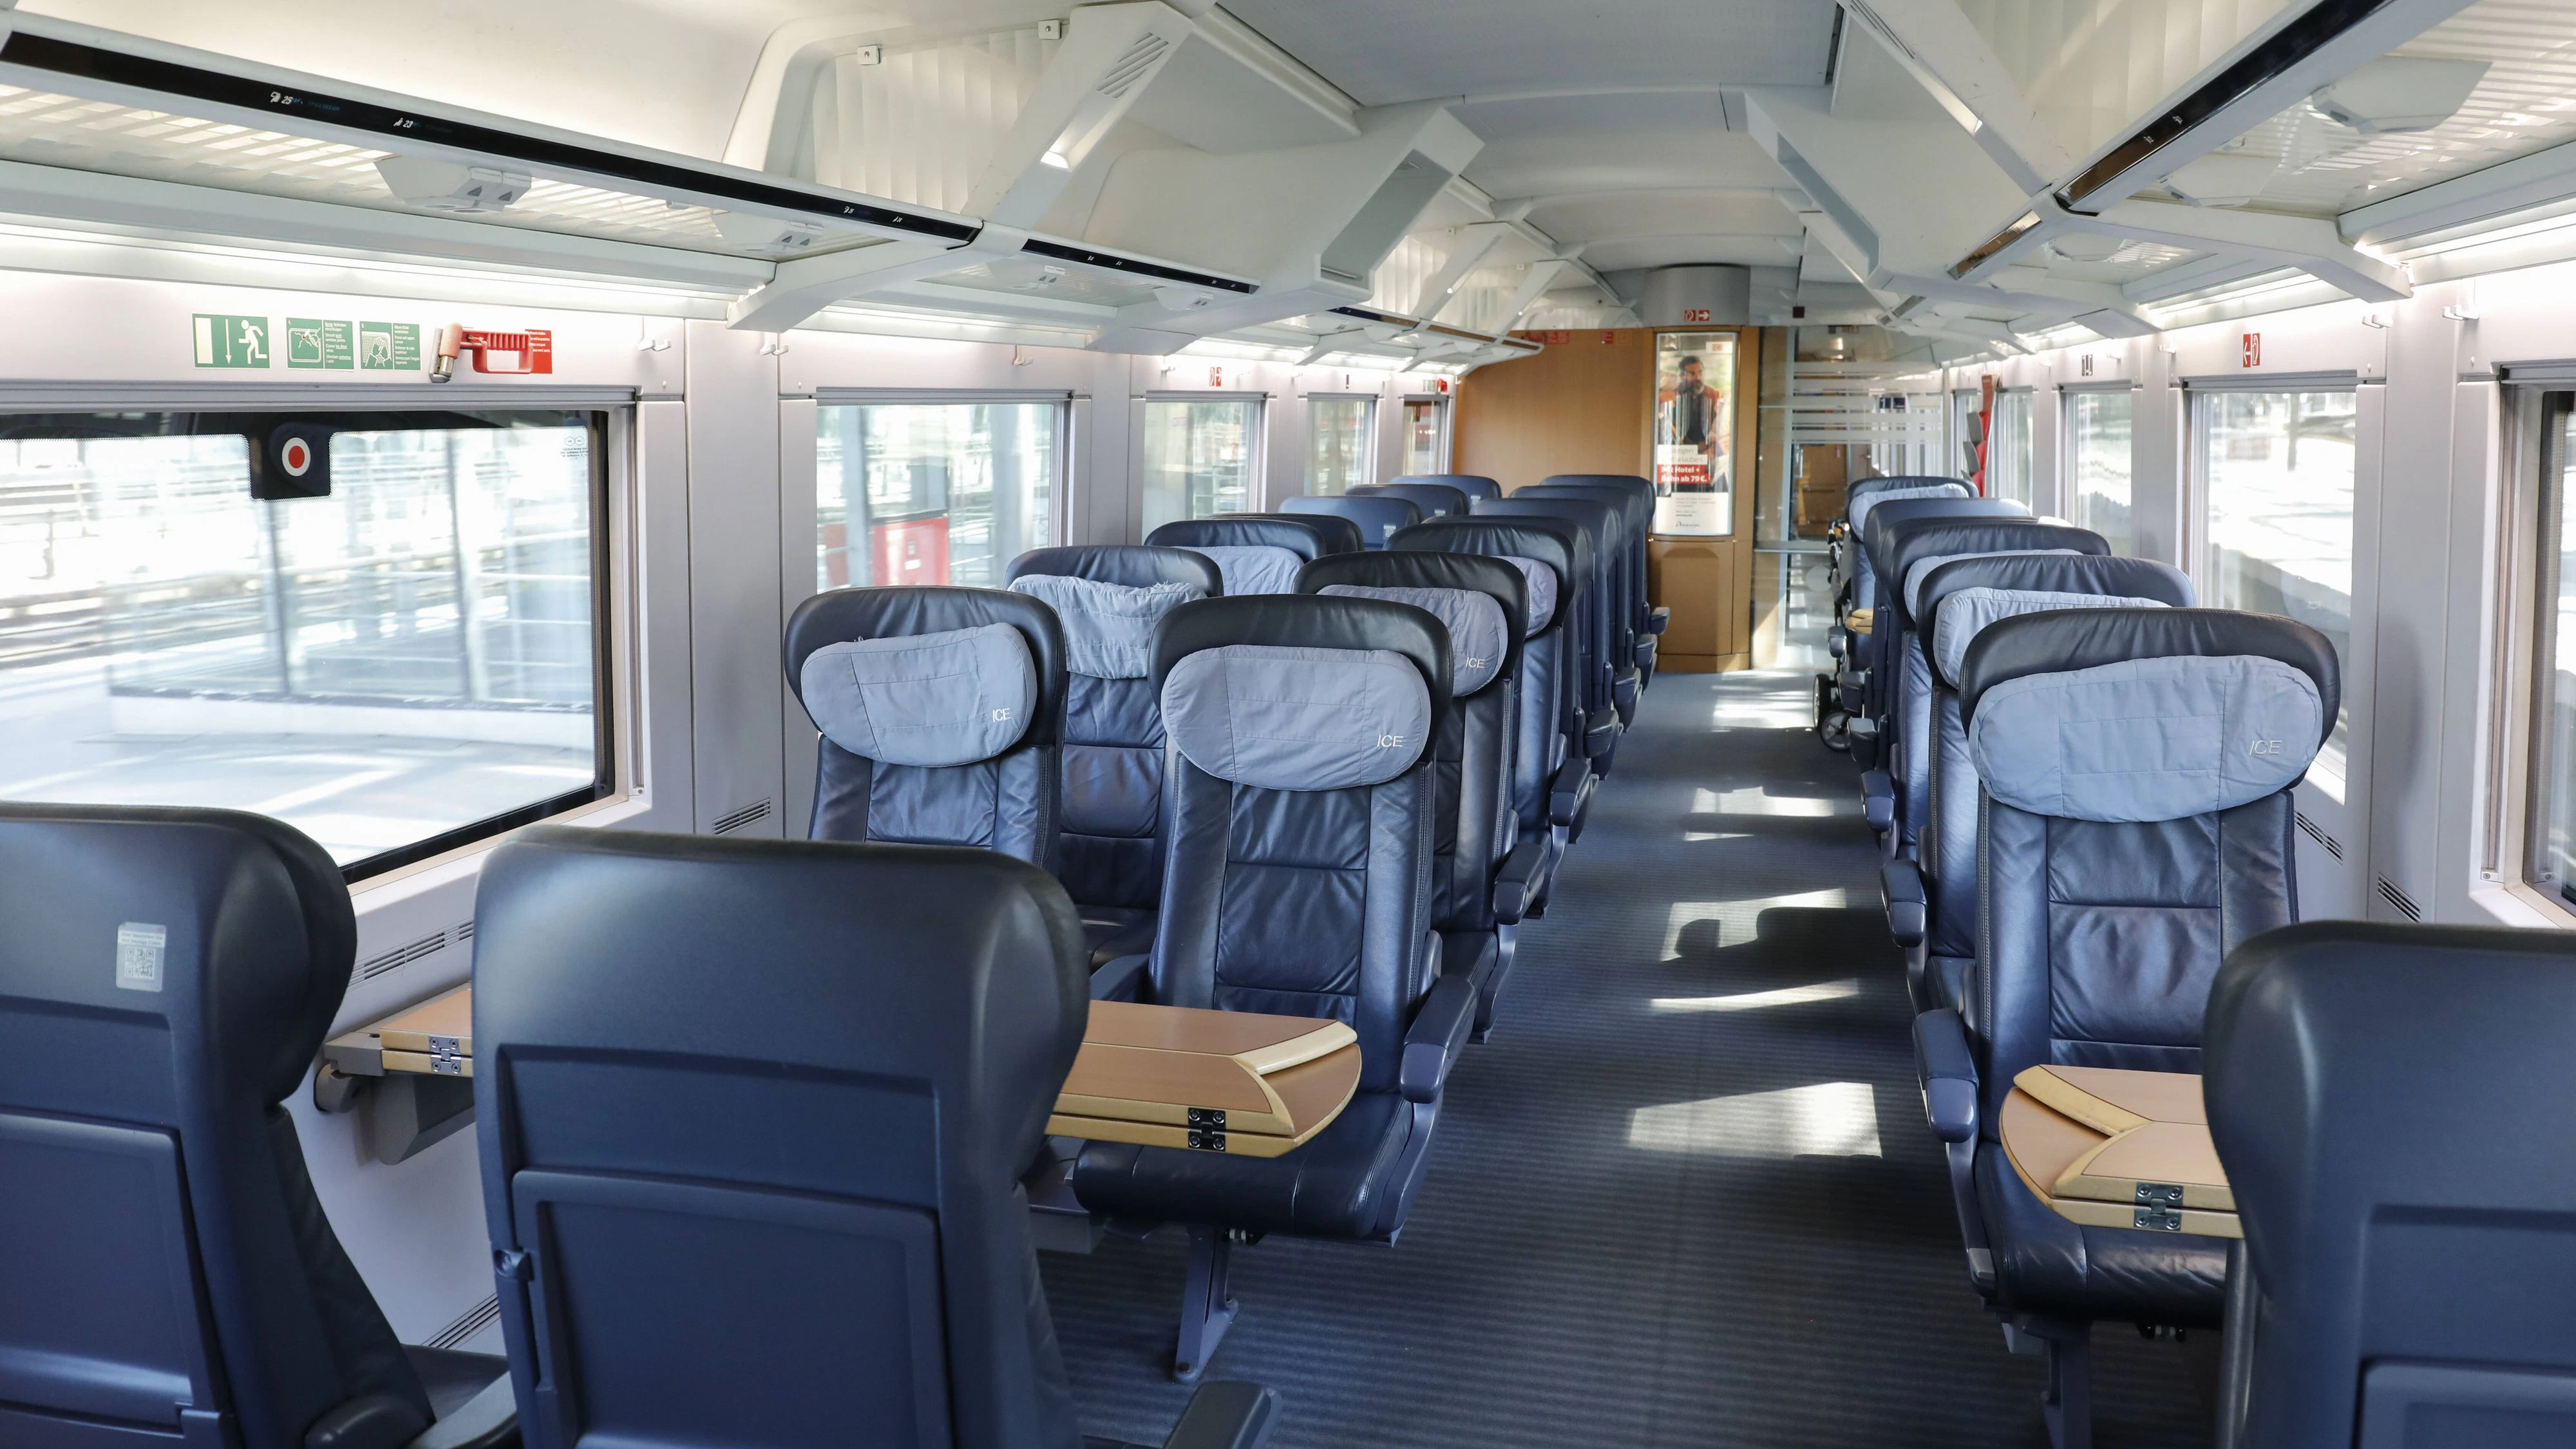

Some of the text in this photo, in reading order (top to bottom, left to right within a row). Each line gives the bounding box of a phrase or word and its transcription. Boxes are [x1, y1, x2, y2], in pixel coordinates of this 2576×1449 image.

[281, 96, 294, 104] 25
[402, 120, 413, 128] 23
[1465, 657, 1485, 668] ICE
[992, 708, 1011, 723] ICE
[1377, 735, 1404, 747] ICE
[2248, 740, 2282, 755] ICE
